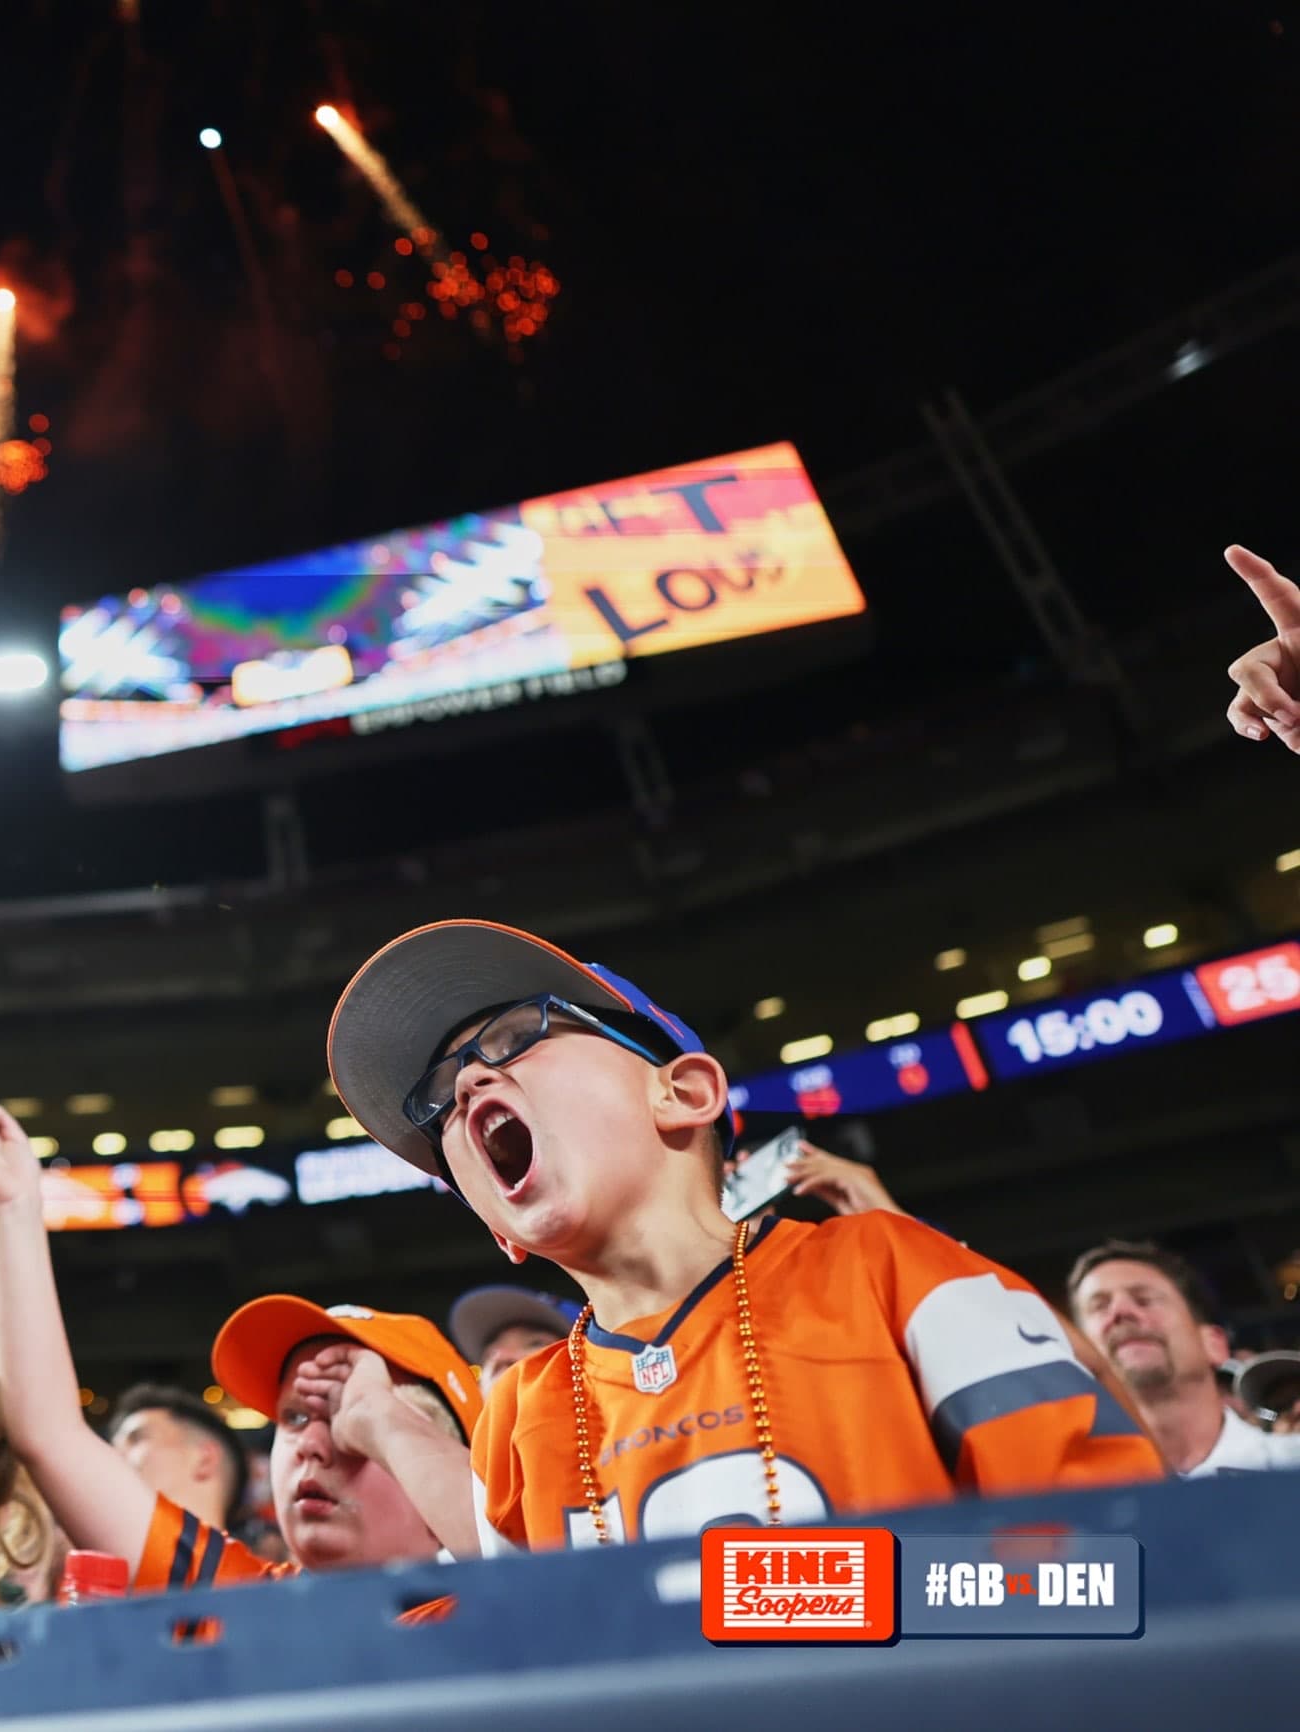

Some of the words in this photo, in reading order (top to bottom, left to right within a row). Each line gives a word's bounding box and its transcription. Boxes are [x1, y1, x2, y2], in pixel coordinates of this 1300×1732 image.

[1218, 954, 1300, 1012] 25
[1007, 991, 1163, 1063] 15:00
[641, 1361, 669, 1386] NFL
